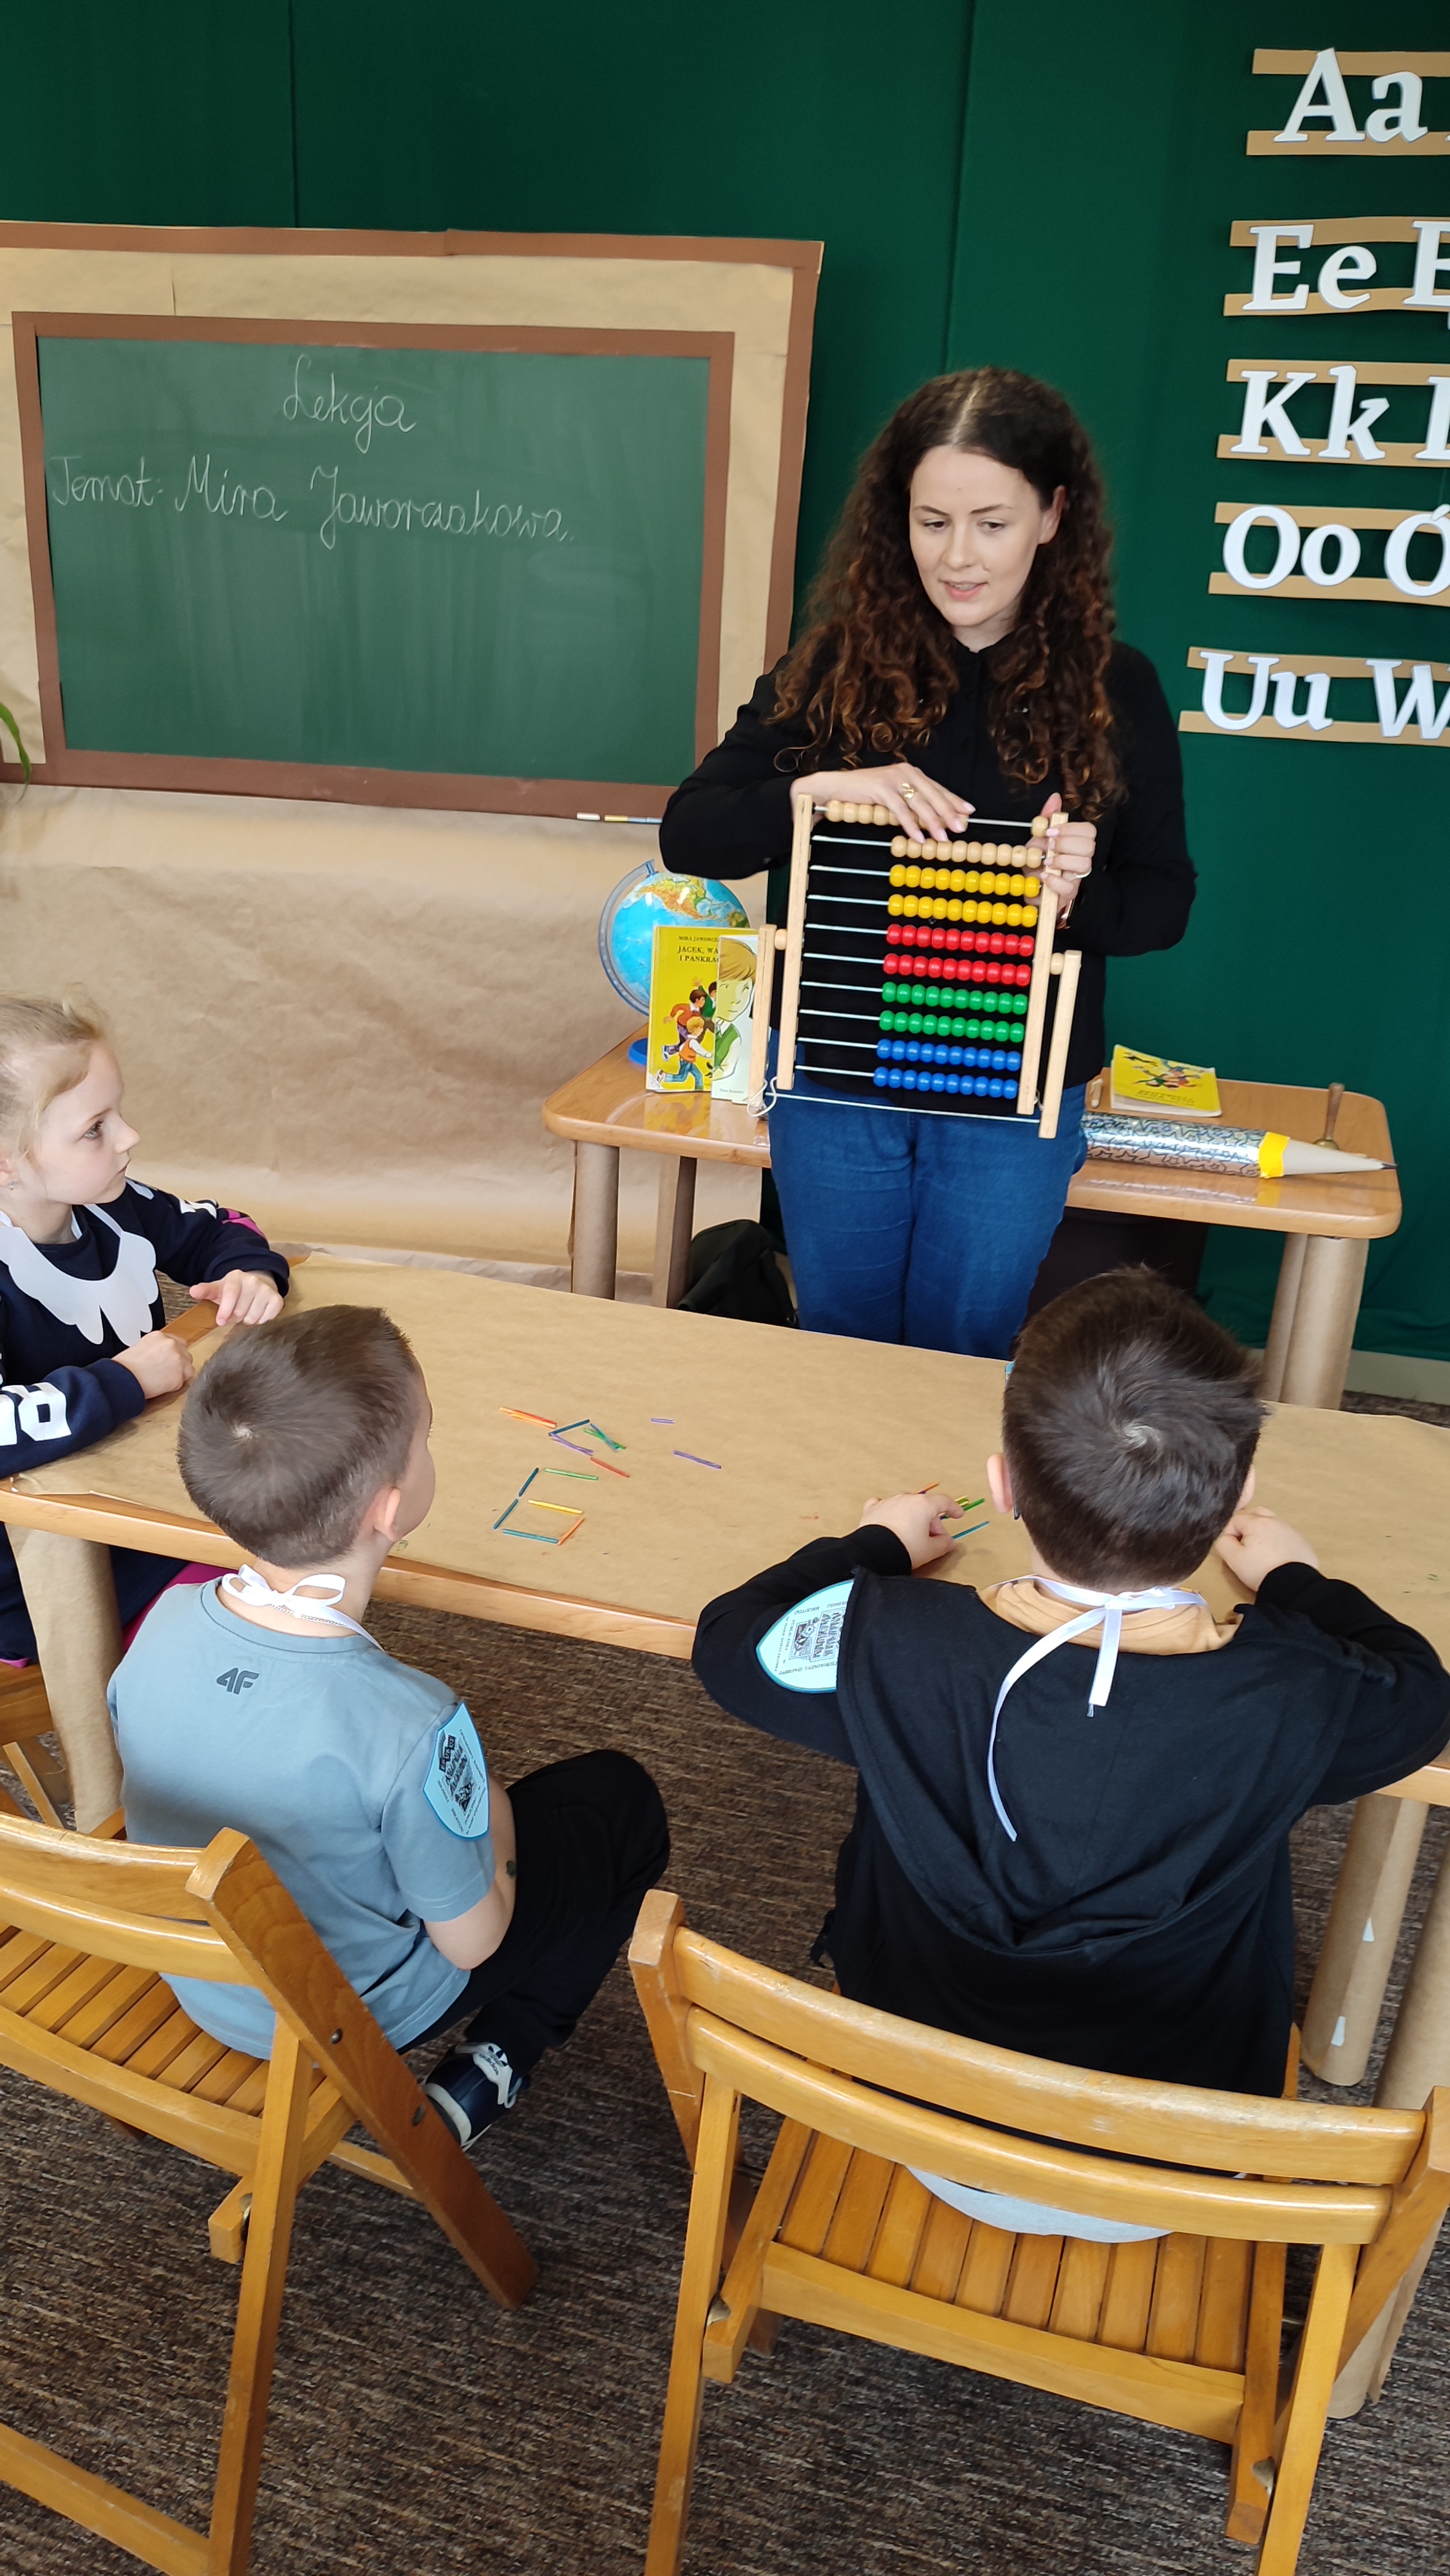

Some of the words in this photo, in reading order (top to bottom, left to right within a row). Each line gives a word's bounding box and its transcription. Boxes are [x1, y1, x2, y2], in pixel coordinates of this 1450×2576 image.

[1273, 47, 1428, 142] Aa
[1243, 223, 1377, 310] Ee
[1230, 365, 1390, 460] Kk
[175, 453, 288, 522] Mira
[1223, 505, 1361, 589] Oo
[1200, 651, 1333, 731] Uu
[677, 945, 704, 954] JACEK,
[216, 1667, 259, 1695] 4F
[479, 2054, 499, 2076] adidas
